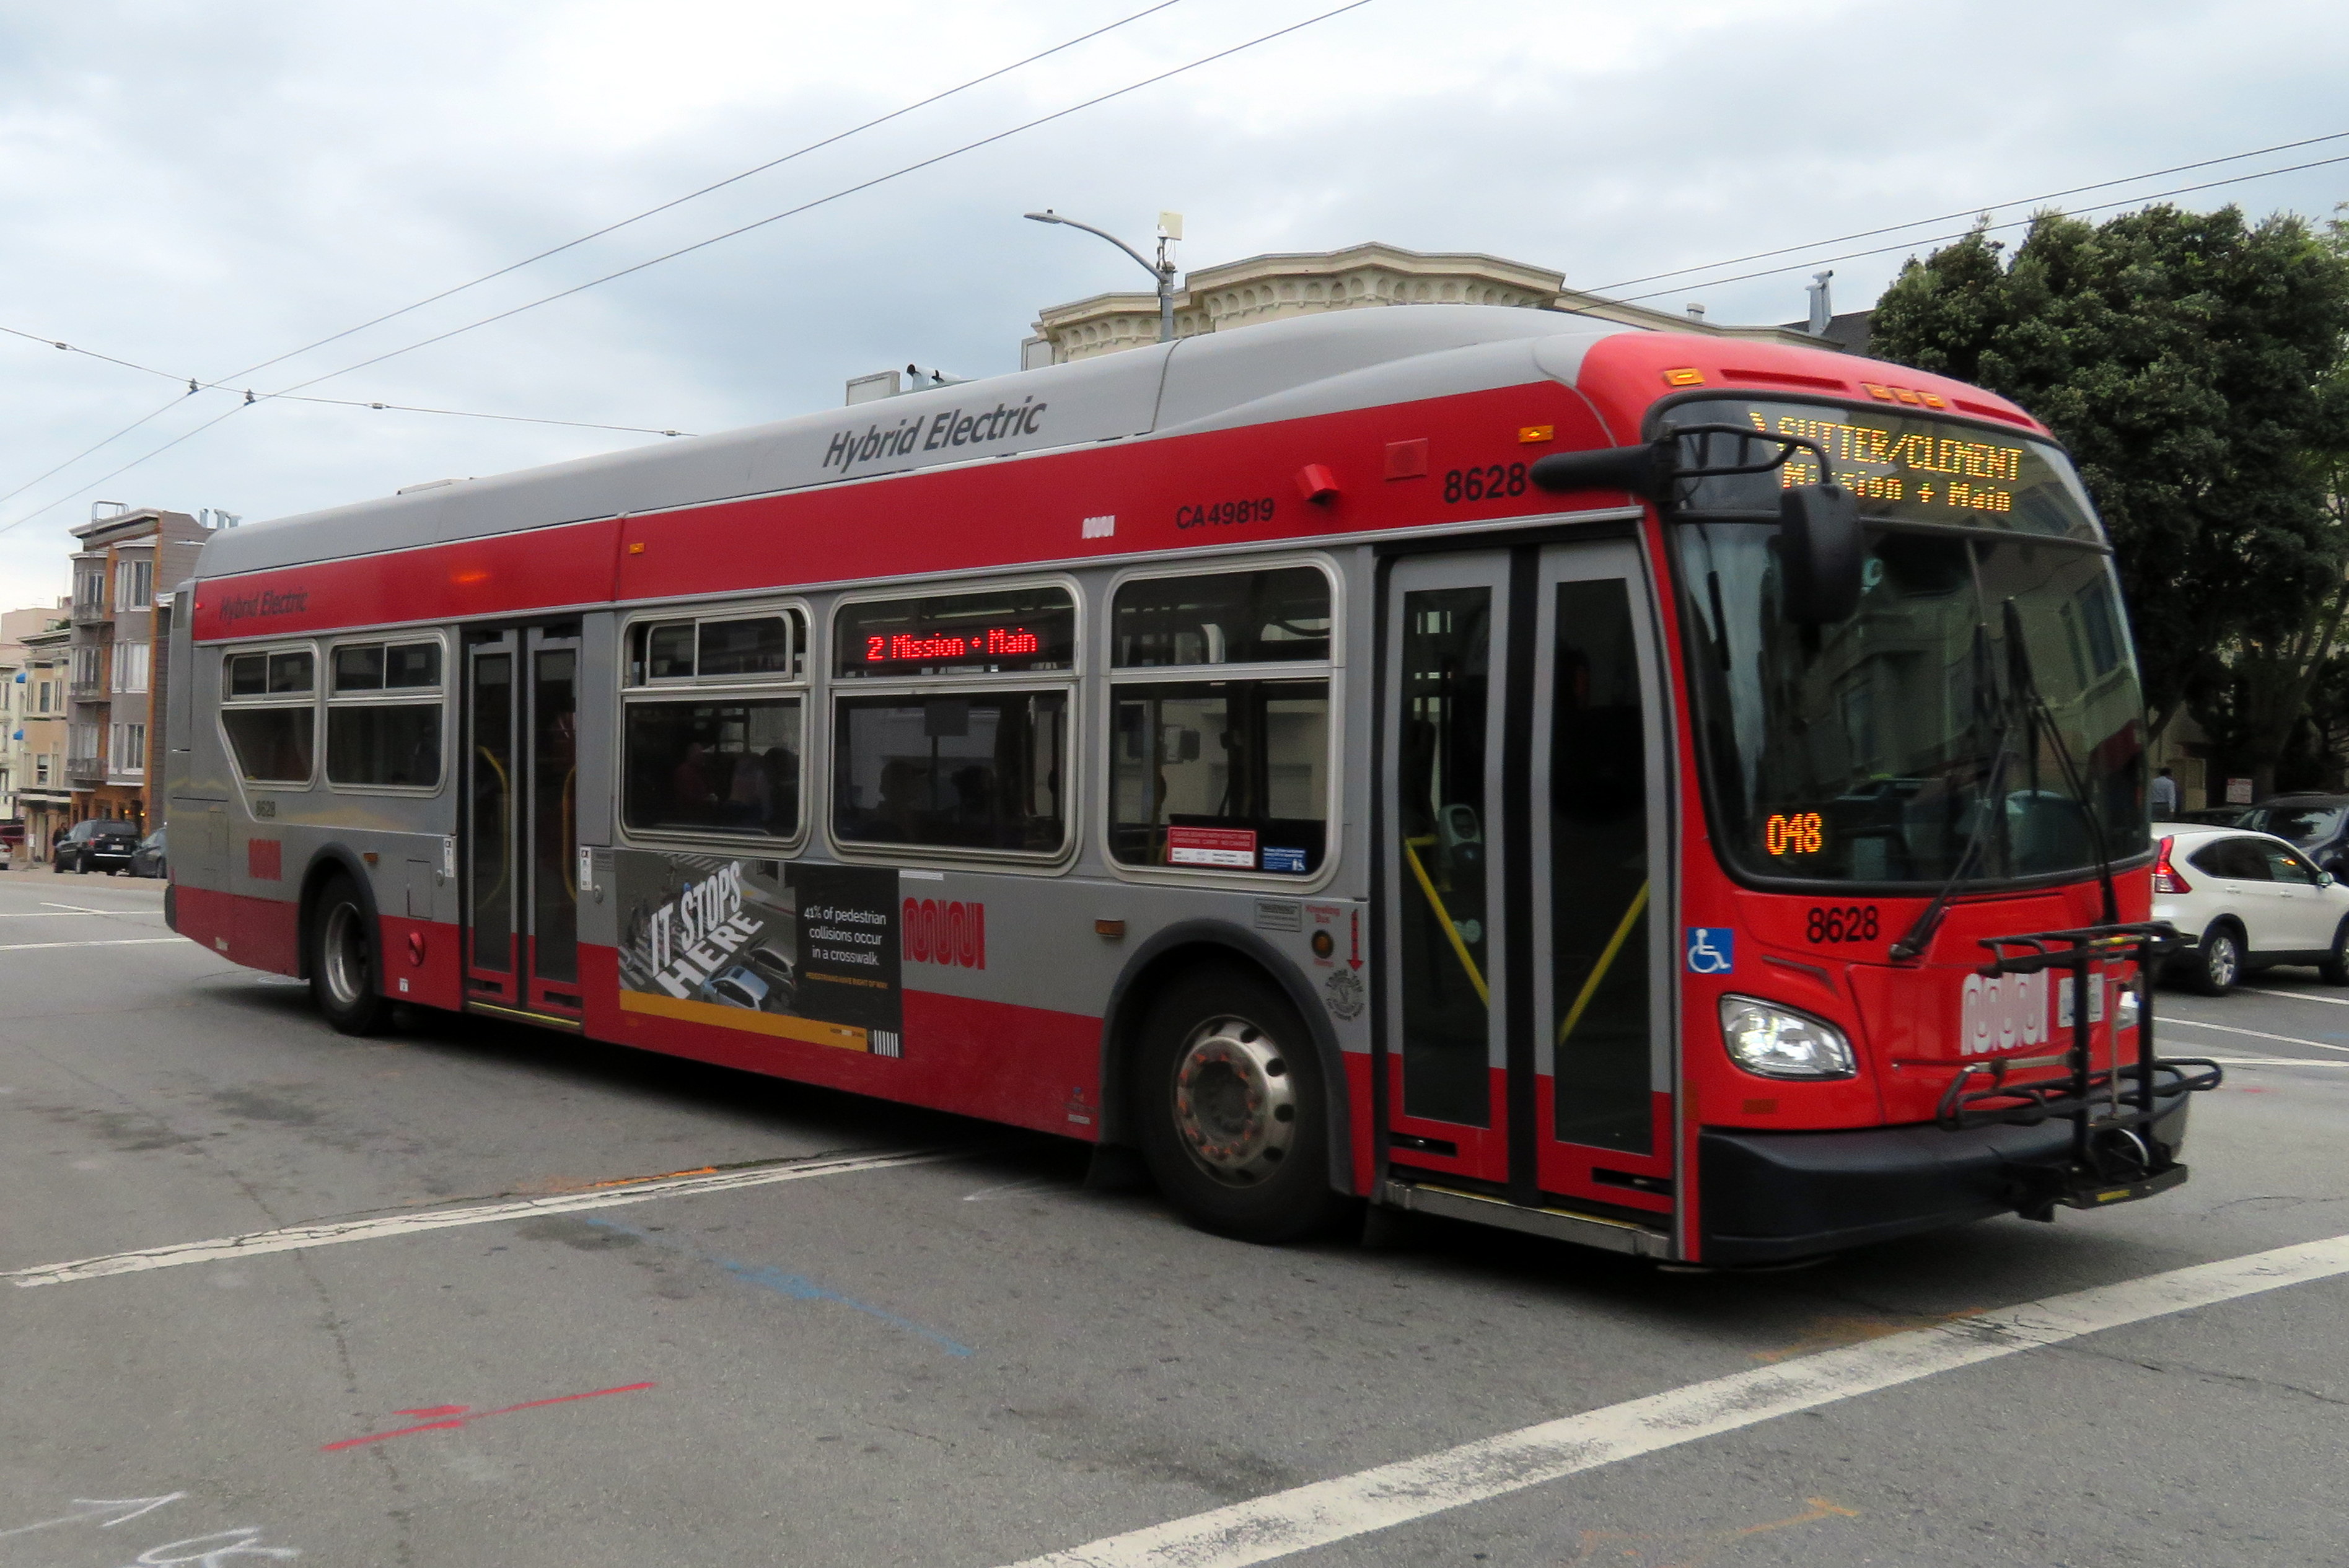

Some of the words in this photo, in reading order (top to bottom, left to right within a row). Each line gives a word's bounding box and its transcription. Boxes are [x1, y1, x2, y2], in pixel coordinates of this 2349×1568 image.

[822, 415, 925, 473] Hybrid
[923, 395, 1048, 451] Electric
[1443, 462, 1526, 503] 8628
[1948, 481, 2011, 512] Main
[1175, 498, 1275, 529] CA49819
[260, 586, 309, 616] Electric
[867, 636, 884, 660] 2
[892, 633, 965, 659] Mission
[988, 628, 1037, 654] Main
[1767, 813, 1823, 855] 048
[651, 902, 674, 977] IT
[681, 860, 741, 952] STOPS
[804, 905, 822, 920] 41%
[823, 906, 834, 920] of
[835, 908, 887, 925] pedestrian
[1807, 905, 1879, 944] 8628
[809, 926, 853, 942] collisions
[854, 932, 883, 945] occur
[655, 911, 765, 999] HERE
[812, 945, 821, 958] in
[822, 949, 829, 960] a
[830, 950, 880, 966] crosswalk.
